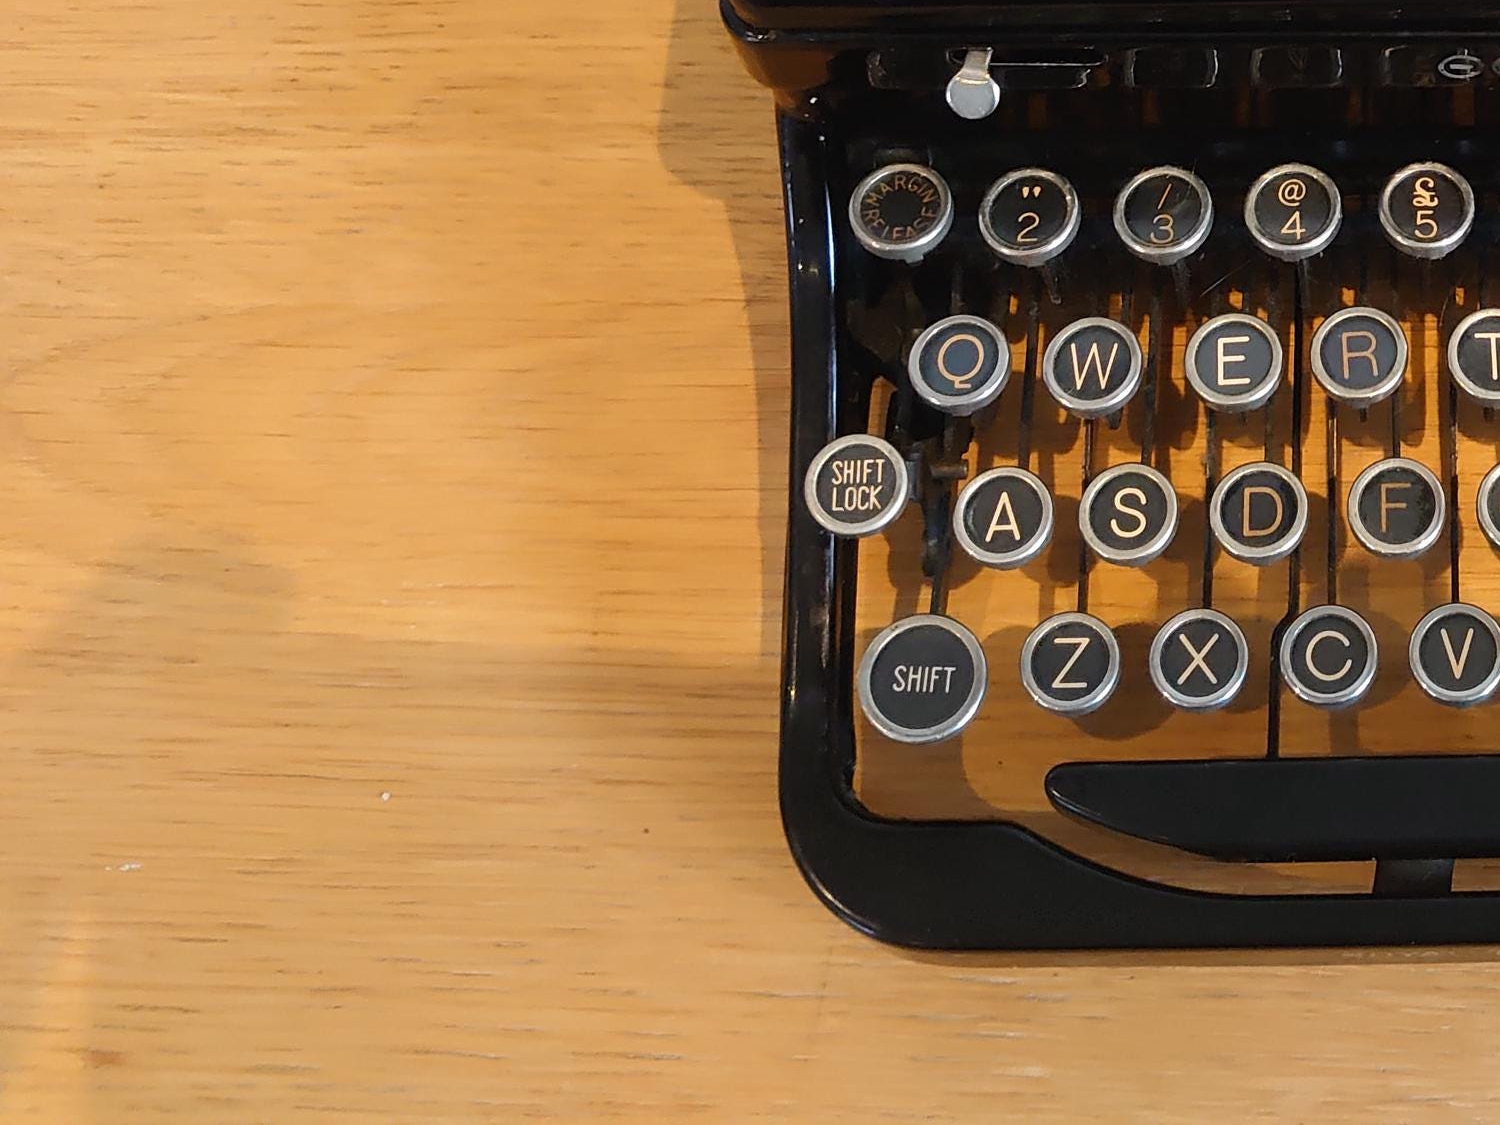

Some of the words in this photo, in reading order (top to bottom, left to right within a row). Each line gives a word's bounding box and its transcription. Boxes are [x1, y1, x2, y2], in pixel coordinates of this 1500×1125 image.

[864, 174, 939, 207] MARGIN
[1278, 179, 1305, 206] @
[1413, 178, 1438, 206] £
[1017, 213, 1039, 242] 2
[1150, 214, 1174, 243] 3
[1281, 211, 1305, 239] 4
[1415, 211, 1437, 238] 5
[937, 333, 984, 389] Q
[1070, 342, 1118, 391] W
[1218, 336, 1250, 385] E
[1342, 331, 1378, 379] R
[832, 459, 885, 484] SHIFT
[832, 485, 883, 512] LOCK
[986, 492, 1020, 542] A
[1111, 488, 1146, 537] S
[1242, 487, 1283, 538] D
[1381, 483, 1410, 532] F
[1052, 638, 1090, 688] Z
[1178, 634, 1218, 684] X
[1305, 630, 1351, 681] C
[1441, 628, 1473, 679] V
[893, 666, 956, 692] SHIFT
